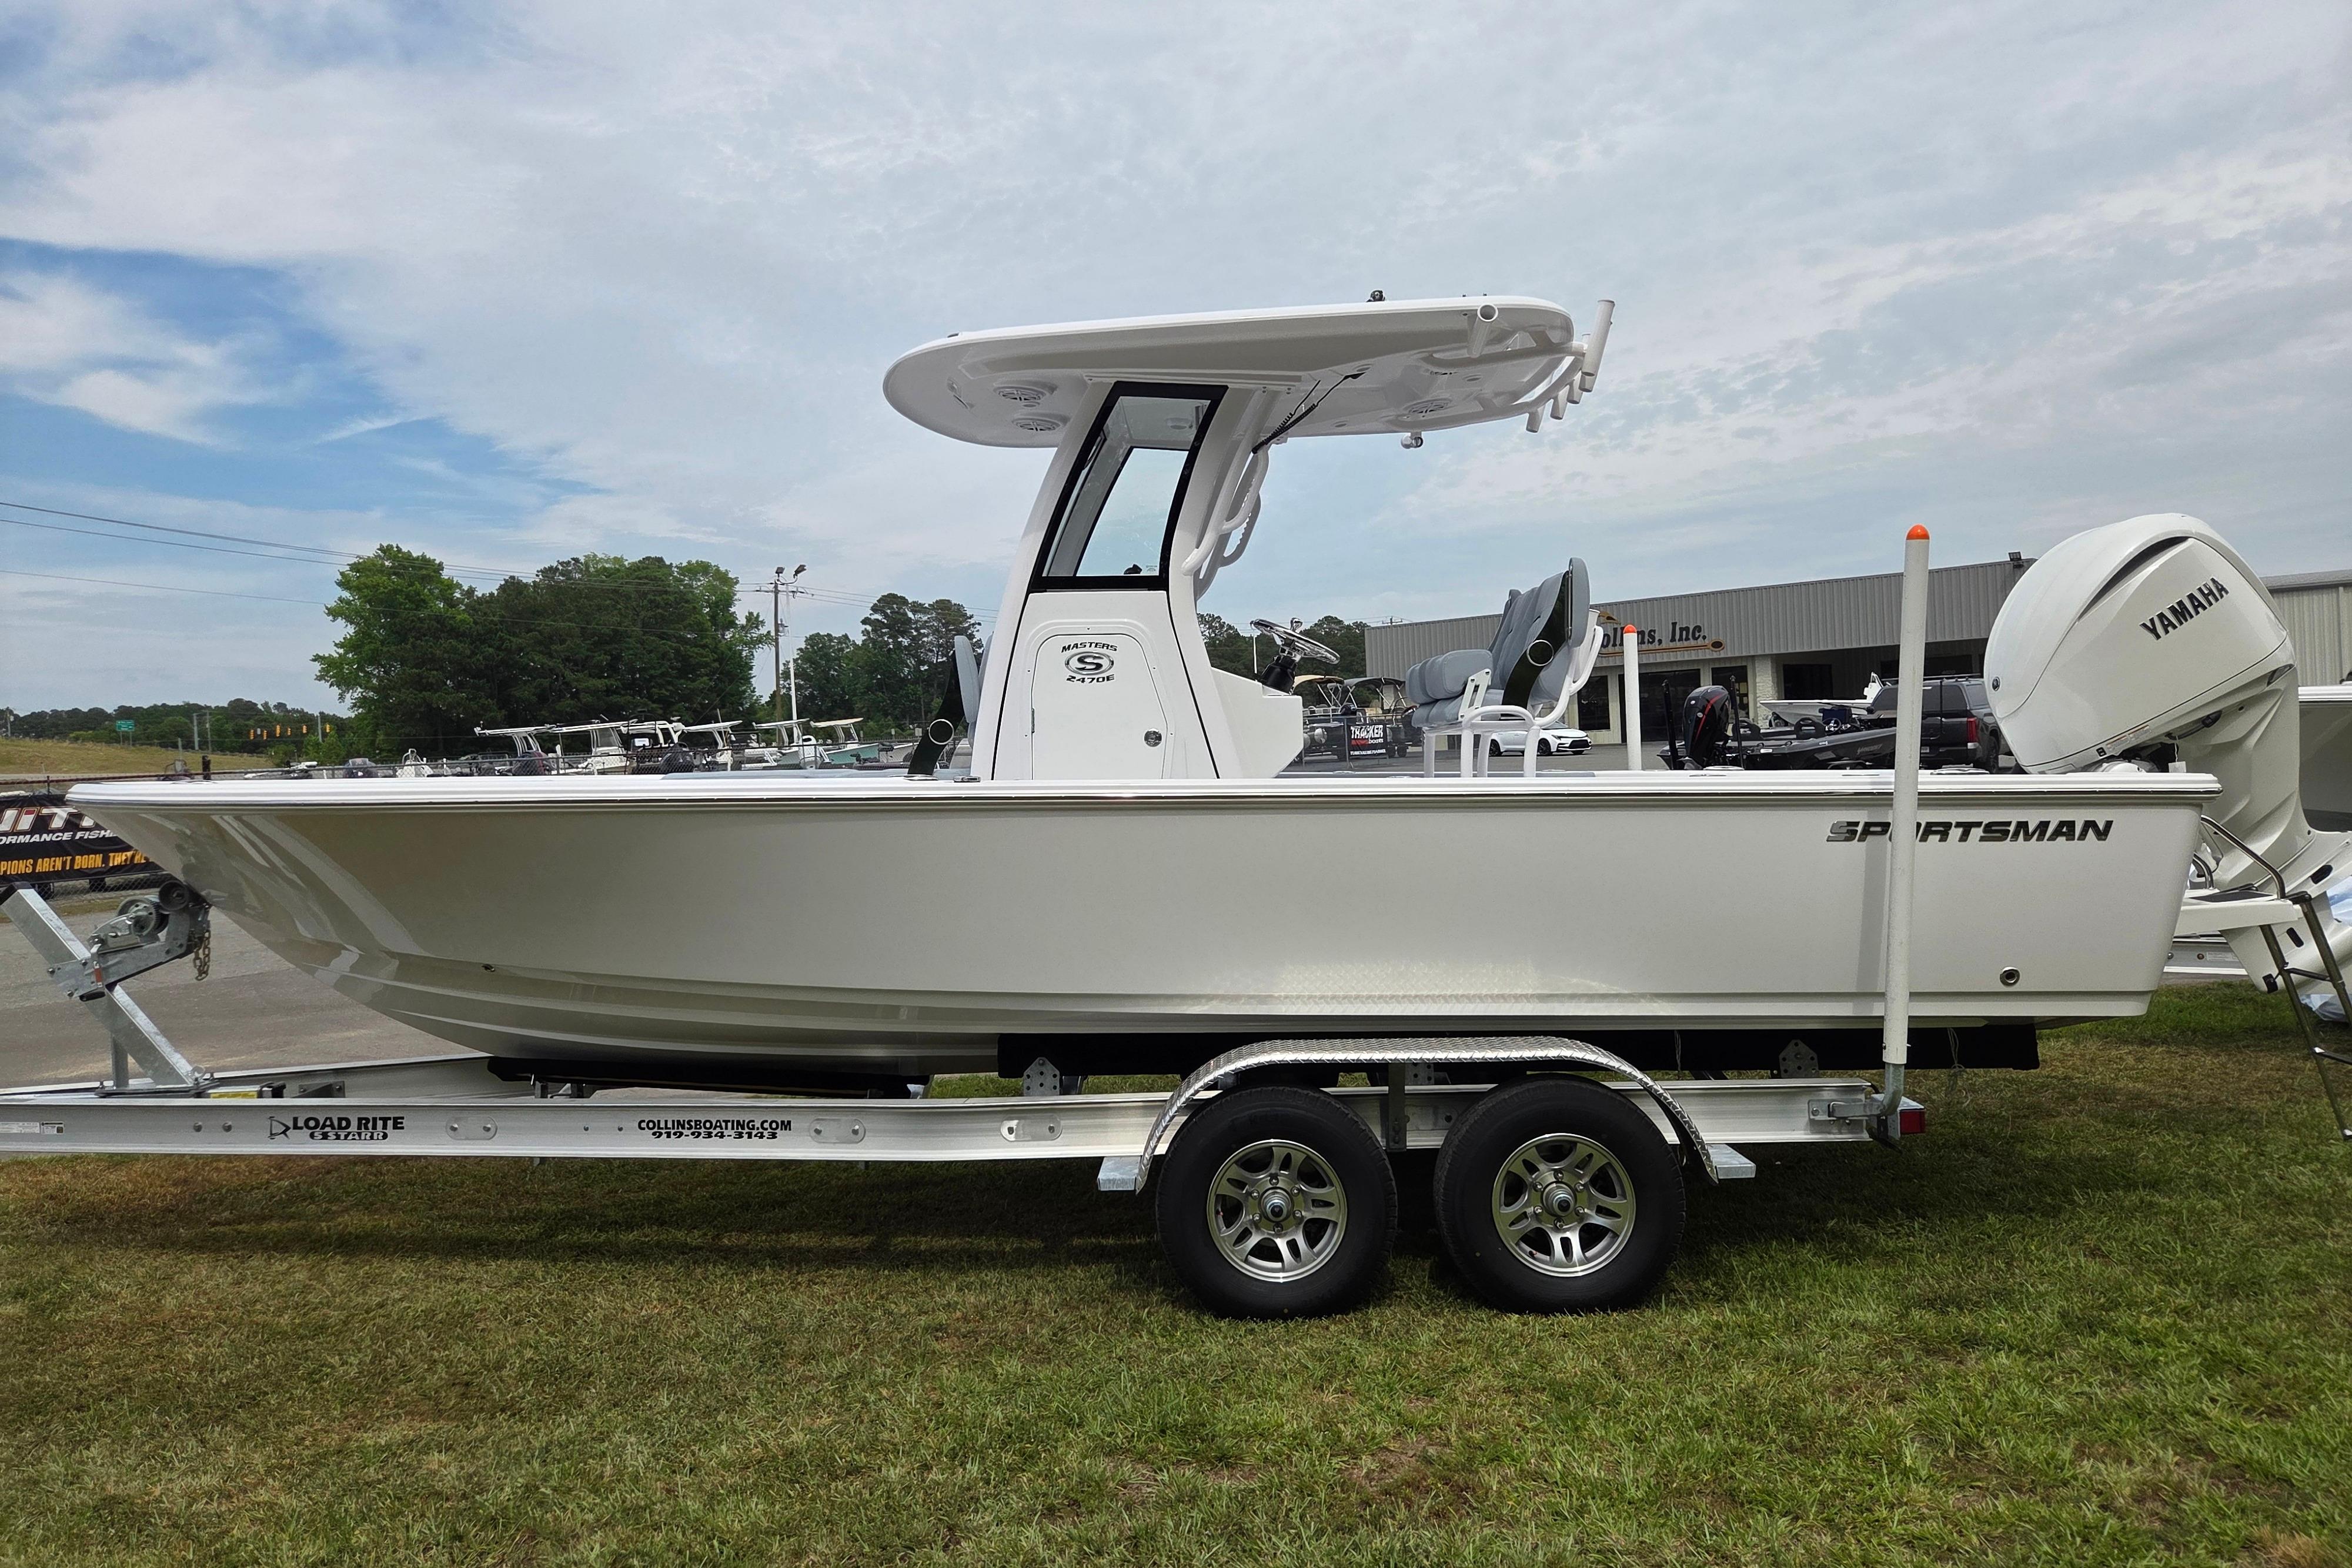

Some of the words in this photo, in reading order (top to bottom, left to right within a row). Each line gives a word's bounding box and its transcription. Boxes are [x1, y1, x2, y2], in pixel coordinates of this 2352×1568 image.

[2139, 577, 2230, 641] YAMAHA
[1669, 621, 1707, 643] Inc.
[1061, 641, 1118, 653] MASTERS
[1066, 674, 1115, 684] 2470E
[1350, 724, 1384, 739] TRACKER
[1826, 820, 2114, 843] SPRTSMAN
[35, 856, 72, 872] AREN'T
[74, 854, 105, 870] BORN.
[292, 1116, 352, 1131] LOAD
[357, 1116, 405, 1131] RITE
[637, 1119, 792, 1131] COLLINSBOATING.COM
[327, 1131, 383, 1140] STARR
[652, 1131, 778, 1139] 919-934-3143
